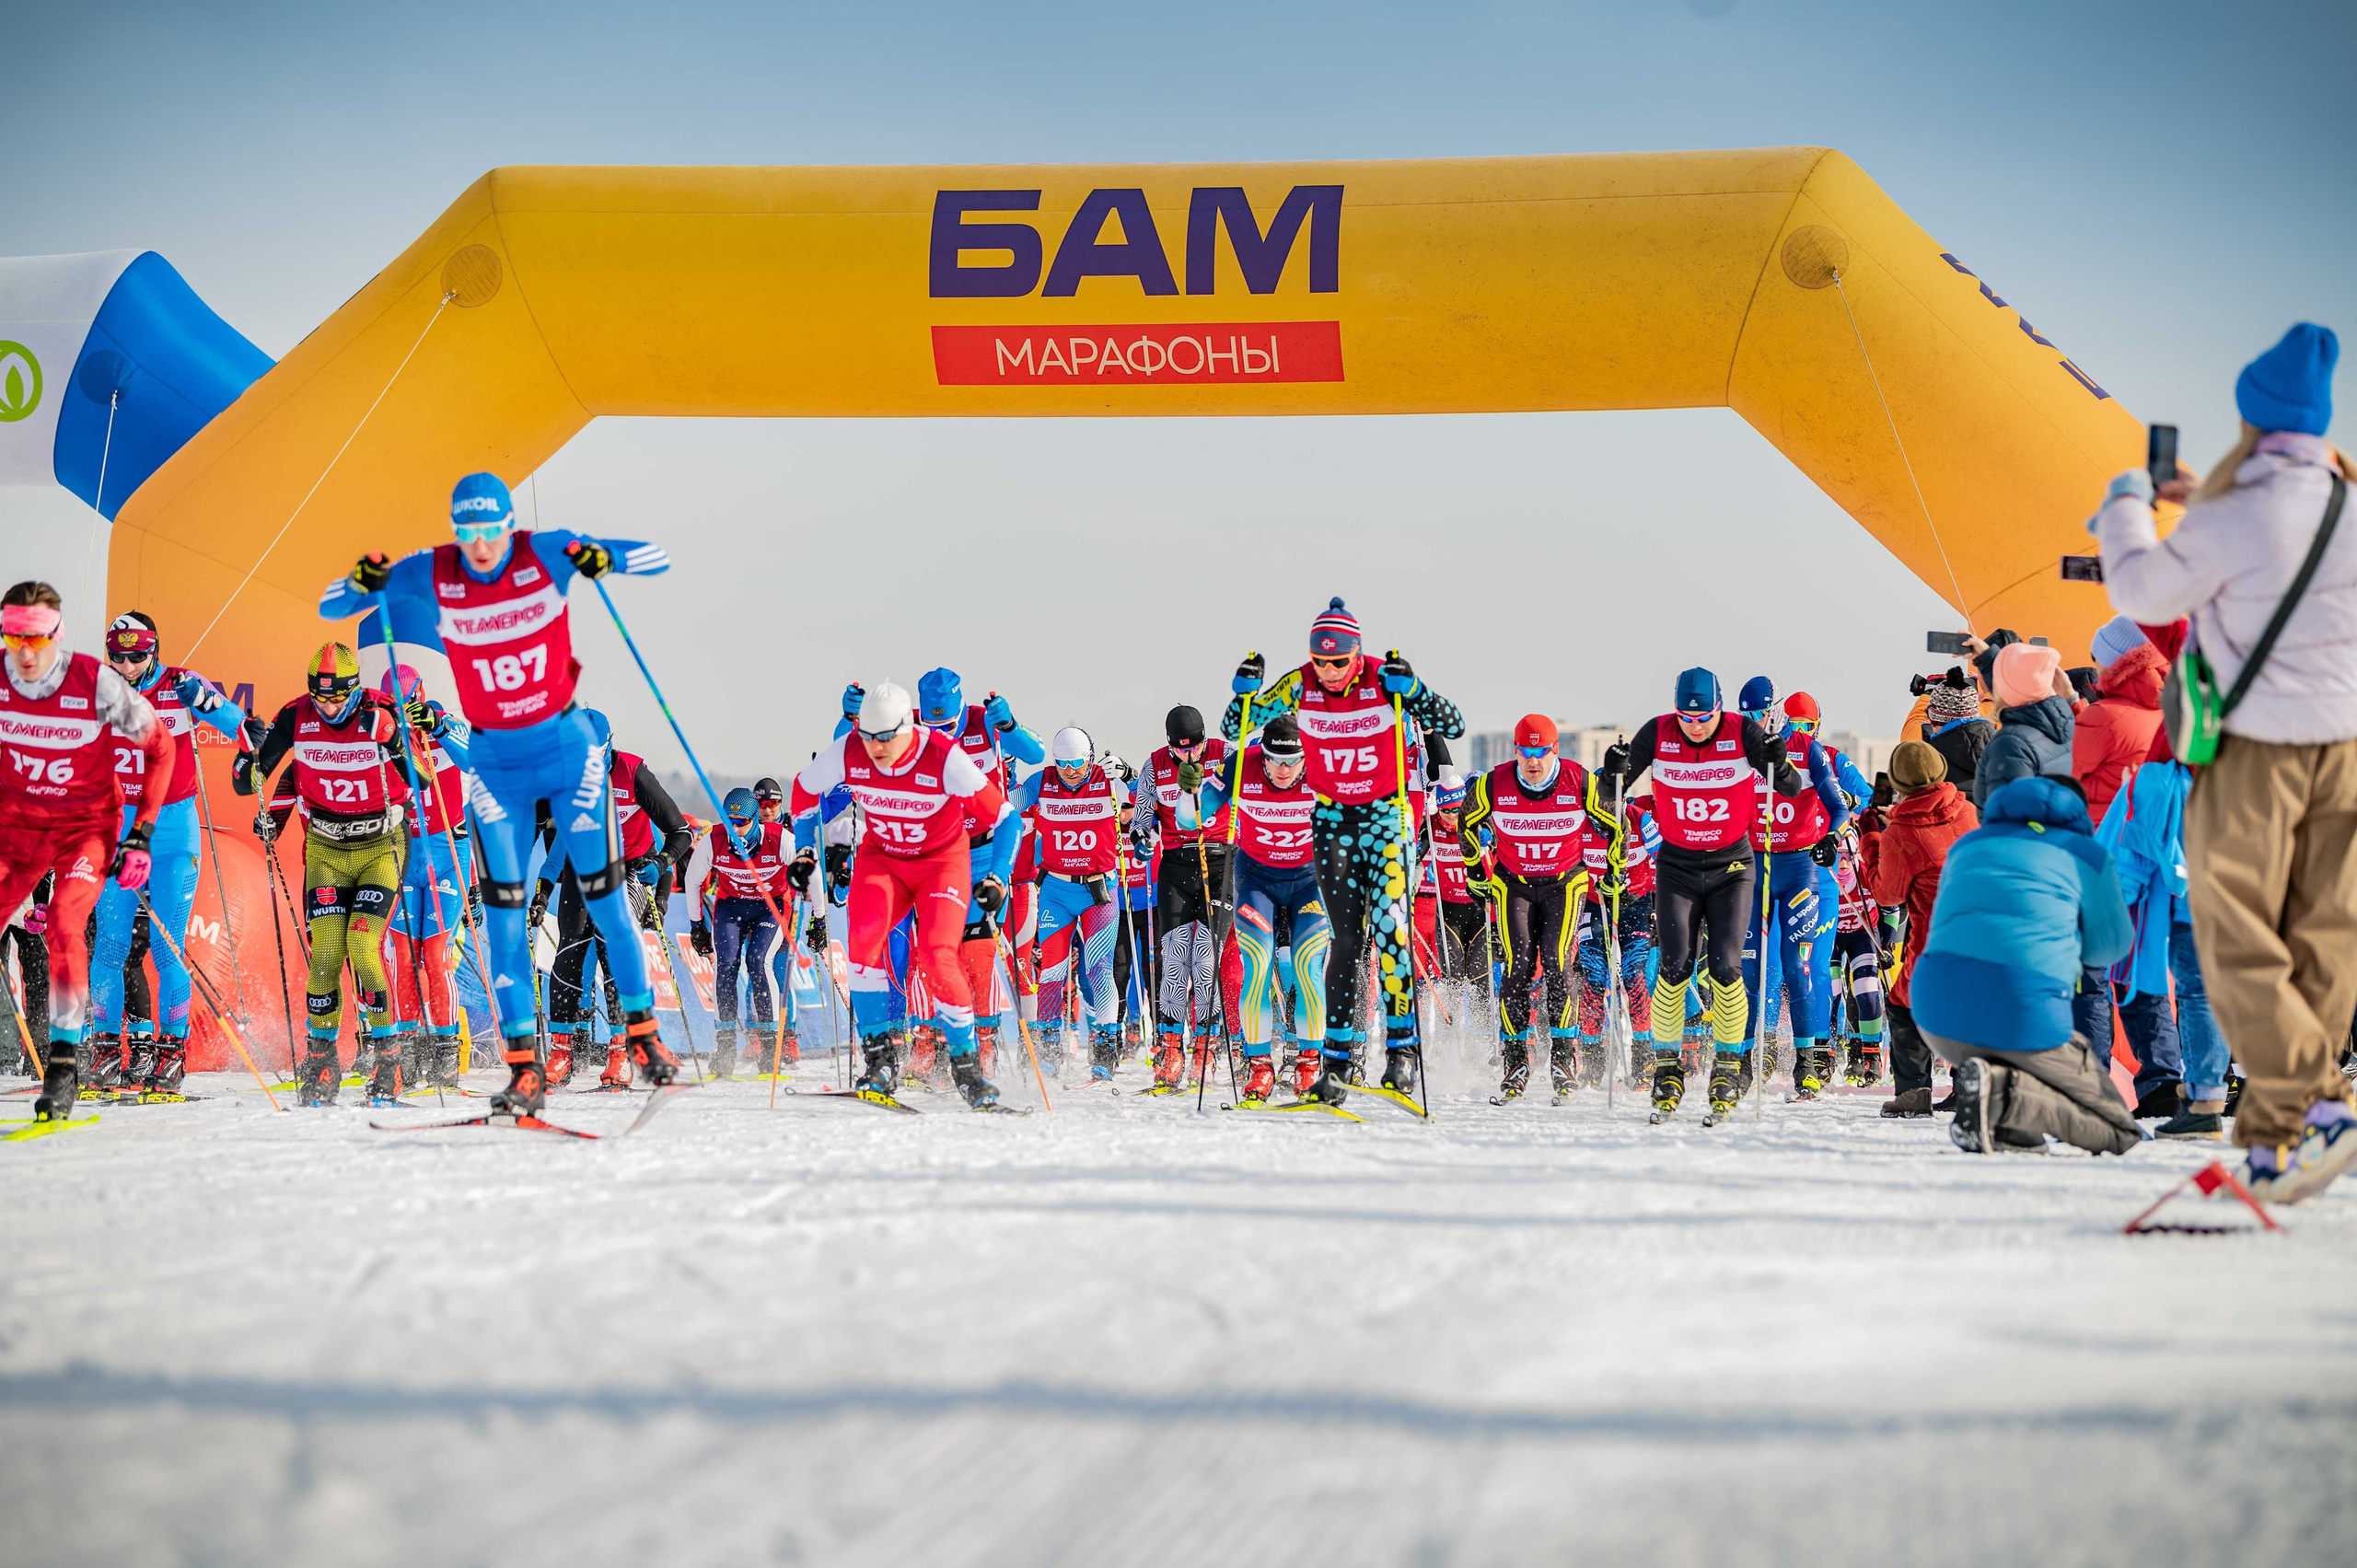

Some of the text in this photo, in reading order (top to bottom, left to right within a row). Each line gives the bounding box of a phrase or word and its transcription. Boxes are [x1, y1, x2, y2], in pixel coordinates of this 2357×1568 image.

[929, 184, 1344, 298] БАМ
[994, 334, 1280, 377] МАРАФОНЫ
[471, 642, 548, 692] 187
[8, 748, 75, 785] 176
[1318, 745, 1379, 774] 175
[122, 783, 143, 791] ТЕМЕ
[319, 777, 369, 803] 121
[1436, 788, 1468, 805] USSIA
[1672, 796, 1731, 823] 182
[868, 817, 928, 844] 213
[1052, 830, 1097, 852] 120
[1255, 826, 1314, 848] 222
[1436, 847, 1465, 857] ТЕМЕ
[1515, 842, 1563, 860] 117
